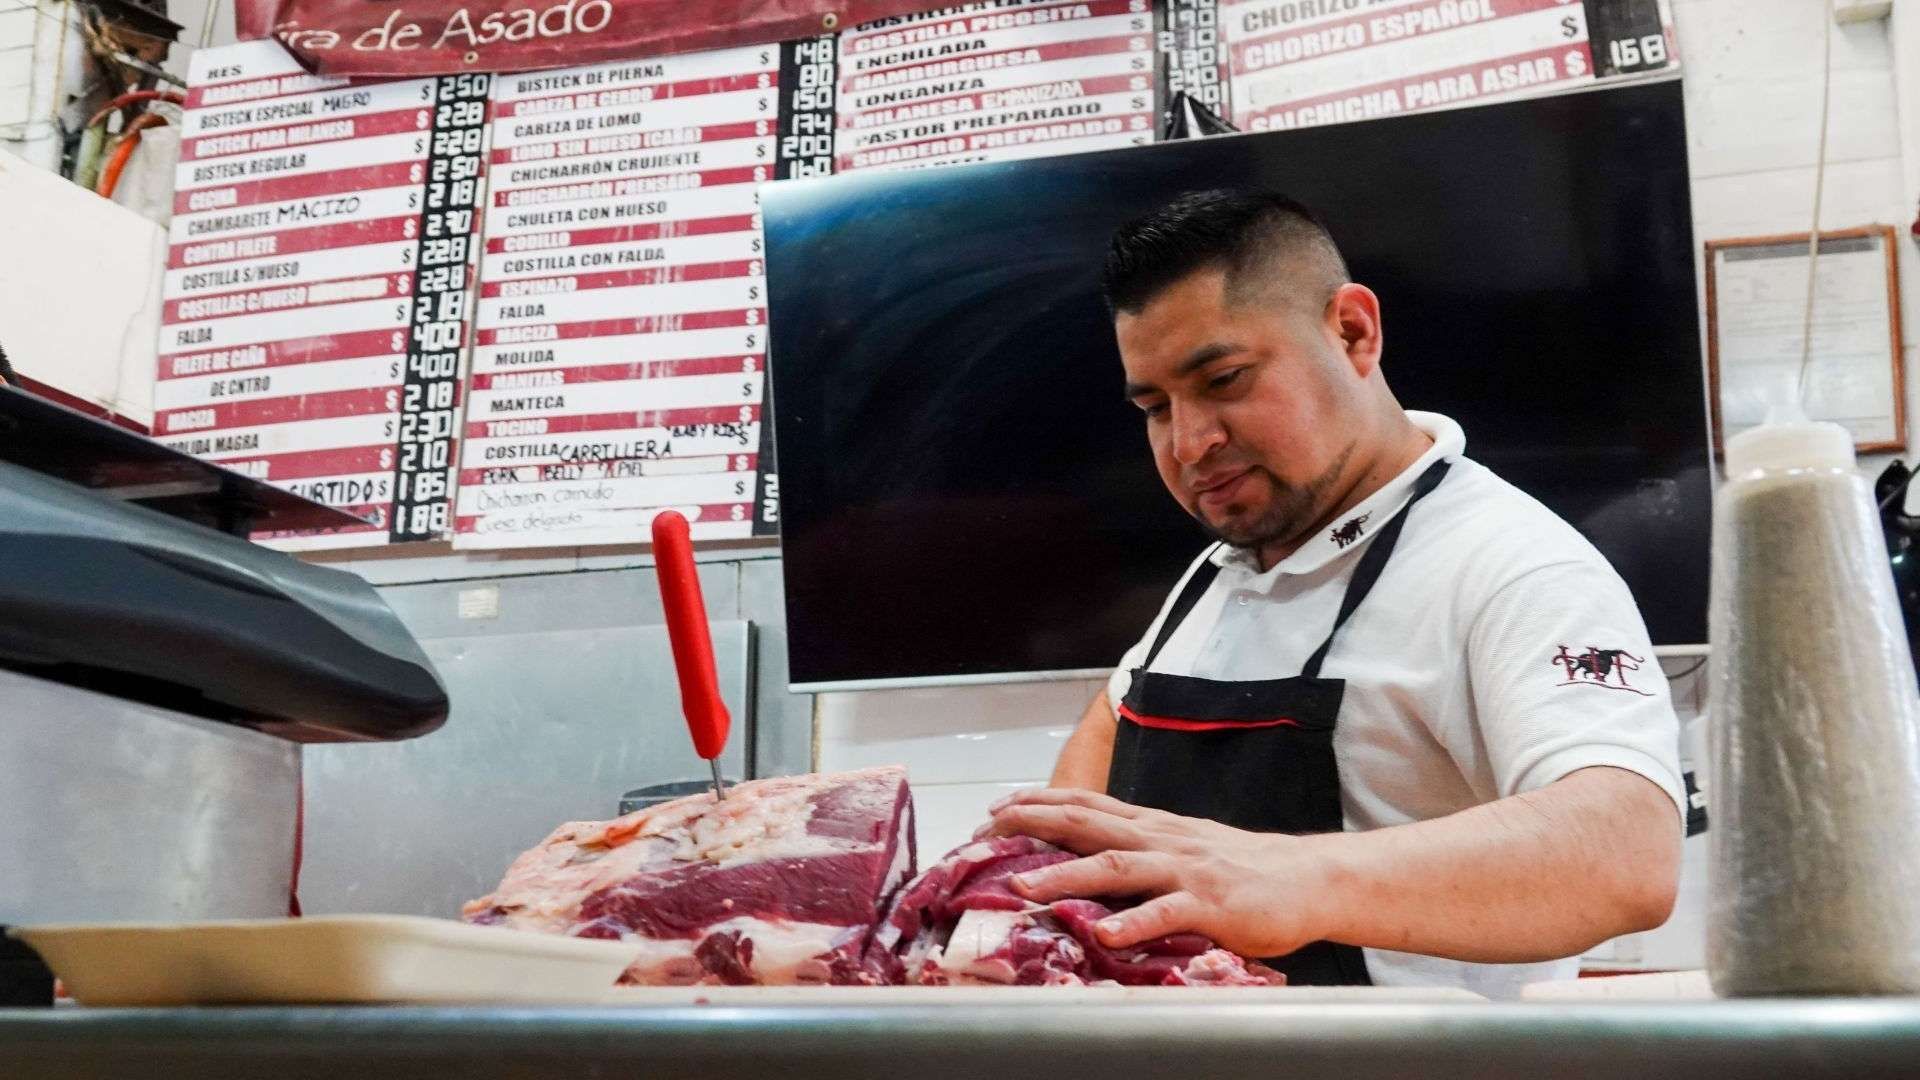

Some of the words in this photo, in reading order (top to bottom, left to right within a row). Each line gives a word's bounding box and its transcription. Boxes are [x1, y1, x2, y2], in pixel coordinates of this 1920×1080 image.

[352, 9, 422, 52] de
[432, 0, 612, 50] Asado
[854, 20, 967, 52] COSTILLA
[970, 4, 1092, 32] PICOSITA
[1244, 22, 1366, 70] CHORIZO
[1369, 0, 1496, 43] ESPAÑOL
[1561, 16, 1579, 39] $
[517, 74, 582, 93] BISTECK
[586, 71, 604, 84] DE
[608, 64, 664, 82] PIERNA
[795, 39, 833, 65] 148
[854, 49, 1042, 90] HAMBURGUESA
[857, 39, 986, 69] ENCHILADA
[799, 62, 834, 88] 80
[1405, 73, 1478, 108] PARA
[1481, 57, 1556, 93] ASAR
[1564, 50, 1587, 78] $
[1610, 34, 1667, 68] 168
[200, 110, 253, 129] BISTECK
[256, 101, 313, 122] ESPECIAL
[439, 74, 489, 101] 250
[856, 78, 985, 107] LONGANIZA
[436, 101, 484, 128] 228
[513, 120, 571, 137] CABEZA
[576, 117, 594, 131] DE
[599, 111, 642, 128] LOMO
[793, 86, 833, 111] 150
[792, 113, 832, 135] 174
[854, 97, 976, 128] MILANESA
[856, 121, 945, 146] PASTOR
[954, 102, 1101, 130] PREPARADO
[193, 162, 246, 181] BISTECK
[249, 153, 306, 174] REGULAR
[433, 128, 482, 155] 228
[853, 137, 965, 168] SUADERO
[970, 118, 1123, 150] PREPARADO
[432, 155, 480, 181] 250
[510, 159, 613, 183] CHICHARRÓN
[617, 151, 701, 171] CRUJIENTE
[782, 135, 832, 158] 200
[188, 212, 270, 235] CHAMBARETE
[276, 197, 360, 224] MACIZO
[428, 179, 475, 208] 218
[507, 208, 574, 228] CHULETA
[577, 206, 611, 221] CON
[614, 200, 668, 218] HUESO
[182, 269, 239, 290] COSTILLA
[421, 237, 468, 265] 228
[503, 254, 576, 274] COSTILLA
[580, 251, 613, 267] CON
[617, 247, 665, 264] FALDA
[419, 264, 466, 293] 228
[177, 327, 212, 345] FALDA
[416, 290, 463, 323] 218
[499, 304, 545, 320] FALDA
[414, 320, 462, 351] 400
[495, 350, 555, 365] MOLIDA
[210, 380, 226, 397] DE
[229, 375, 271, 395] CNTRO
[409, 352, 457, 380] 400
[404, 381, 454, 412] 218
[490, 395, 565, 412] MANTECA
[216, 433, 258, 452] MAGRA
[401, 410, 452, 442] 230
[401, 440, 448, 471] 210
[485, 443, 559, 460] COSTILLA
[399, 472, 446, 501] 185
[396, 502, 447, 535] 188
